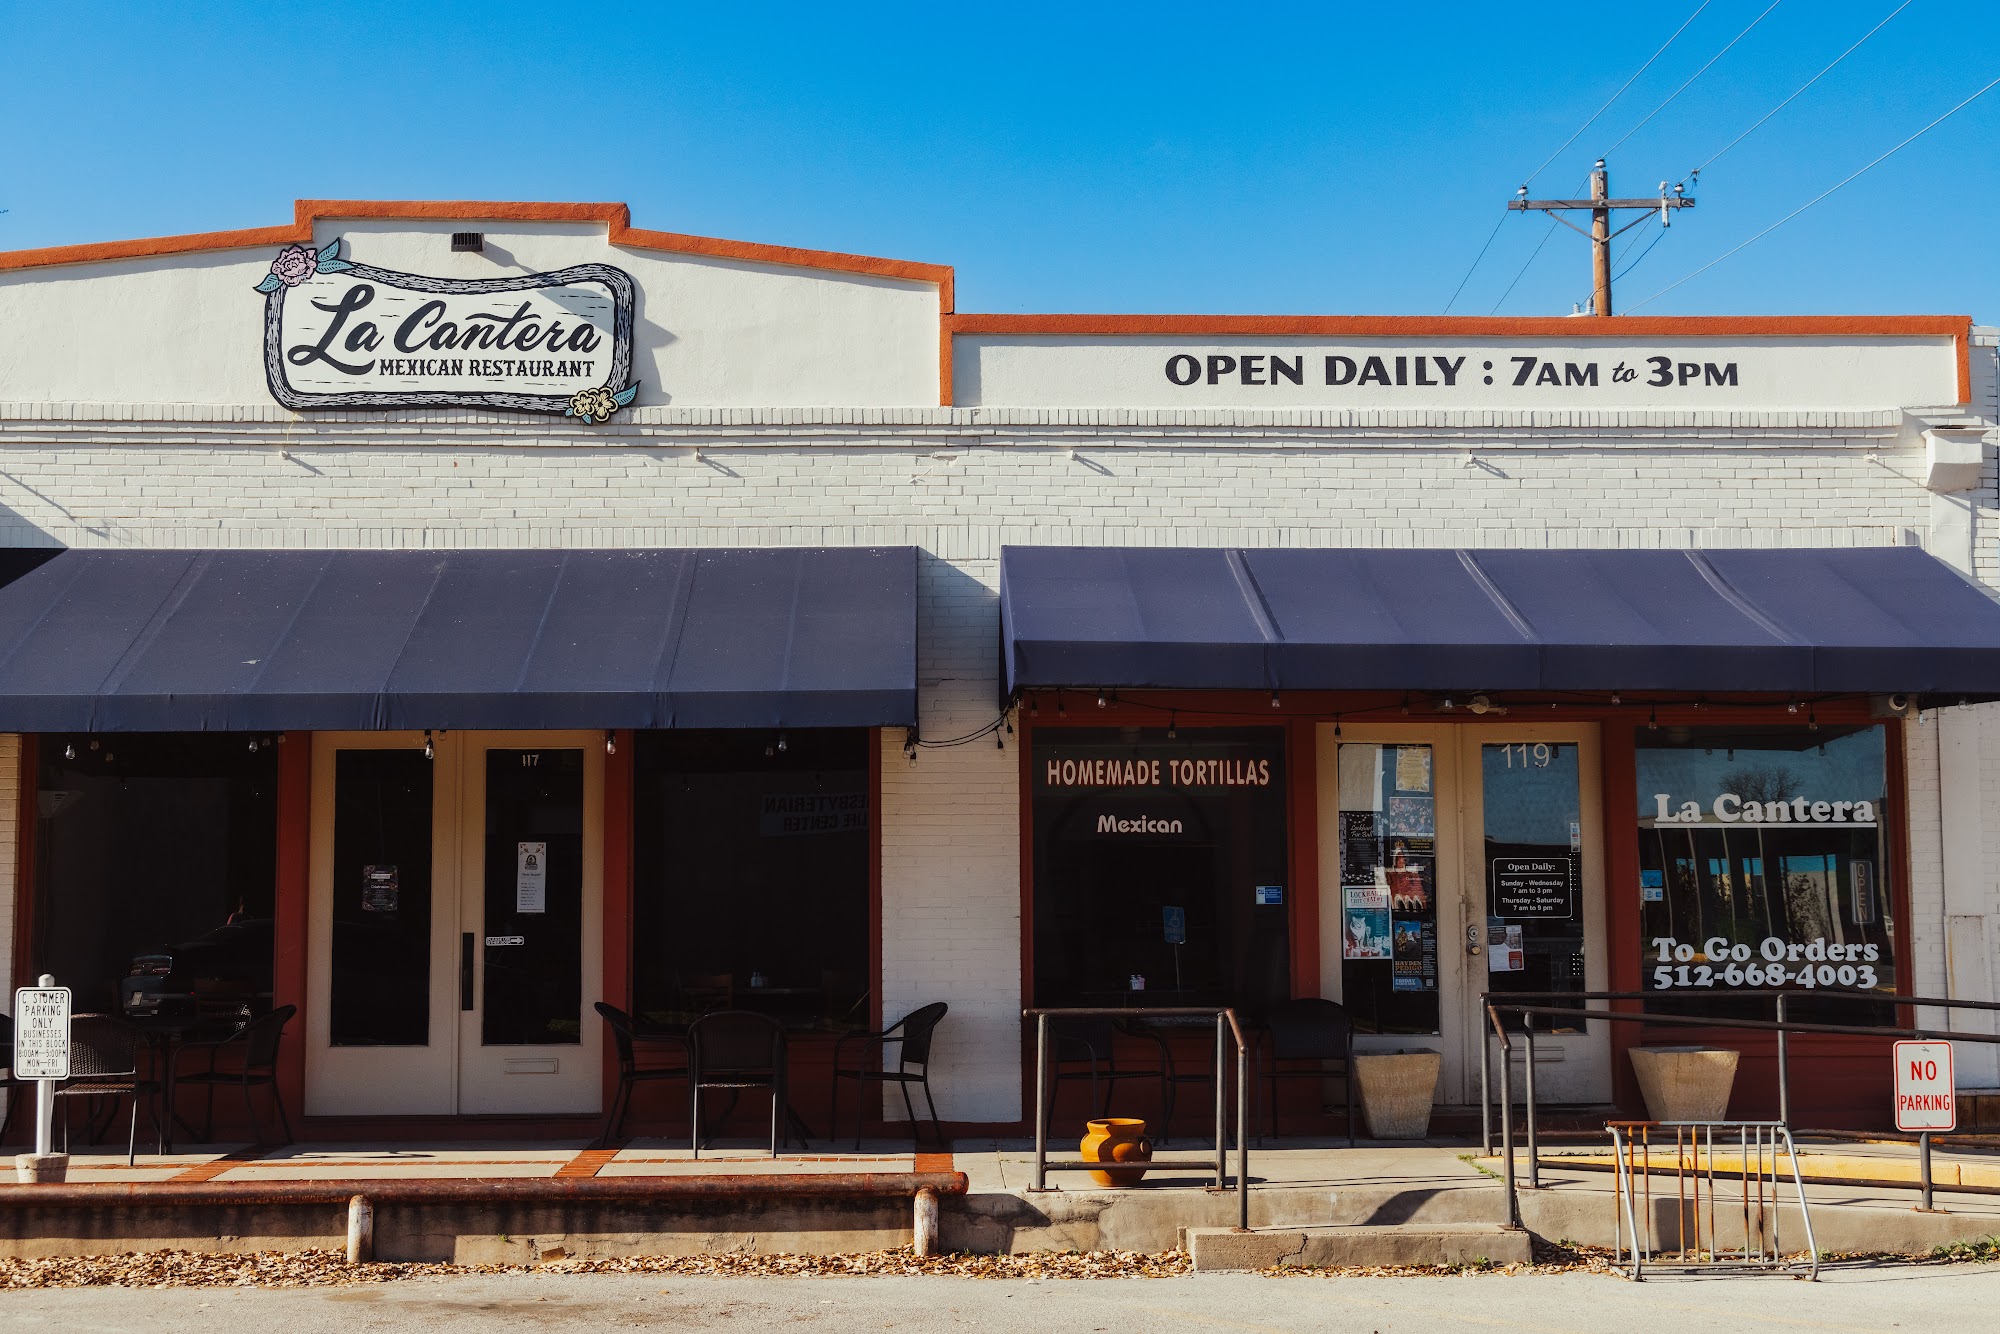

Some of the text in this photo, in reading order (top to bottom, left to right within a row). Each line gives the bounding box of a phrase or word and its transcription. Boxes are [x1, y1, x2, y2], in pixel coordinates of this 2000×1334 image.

[287, 284, 602, 376] La Cantera
[379, 358, 595, 378] MEXICAN RESTAURANT
[1164, 354, 1302, 386] OPEN
[1325, 355, 1466, 386] DAILY
[1511, 355, 1598, 387] 7AM
[1612, 359, 1639, 384] to
[1646, 356, 1738, 387] 3PM
[522, 753, 540, 767] 117
[1501, 743, 1550, 768] 119
[1047, 760, 1270, 785] HOMEMADE TORTILLAS
[1654, 793, 1876, 823] La Cantera
[1097, 814, 1183, 833] Mexican
[1508, 863, 1556, 872] Open Daily:
[1652, 937, 1879, 961] To Go Orders
[1653, 964, 1877, 989] 512-668-4003
[25, 1006, 61, 1016] PARKING
[32, 1018, 53, 1028] ONLY
[19, 1040, 66, 1048] IN THIS BLOCK
[23, 1030, 62, 1038] BUSINESSES
[1911, 1060, 1937, 1080] NO
[1900, 1094, 1950, 1111] PARKING
